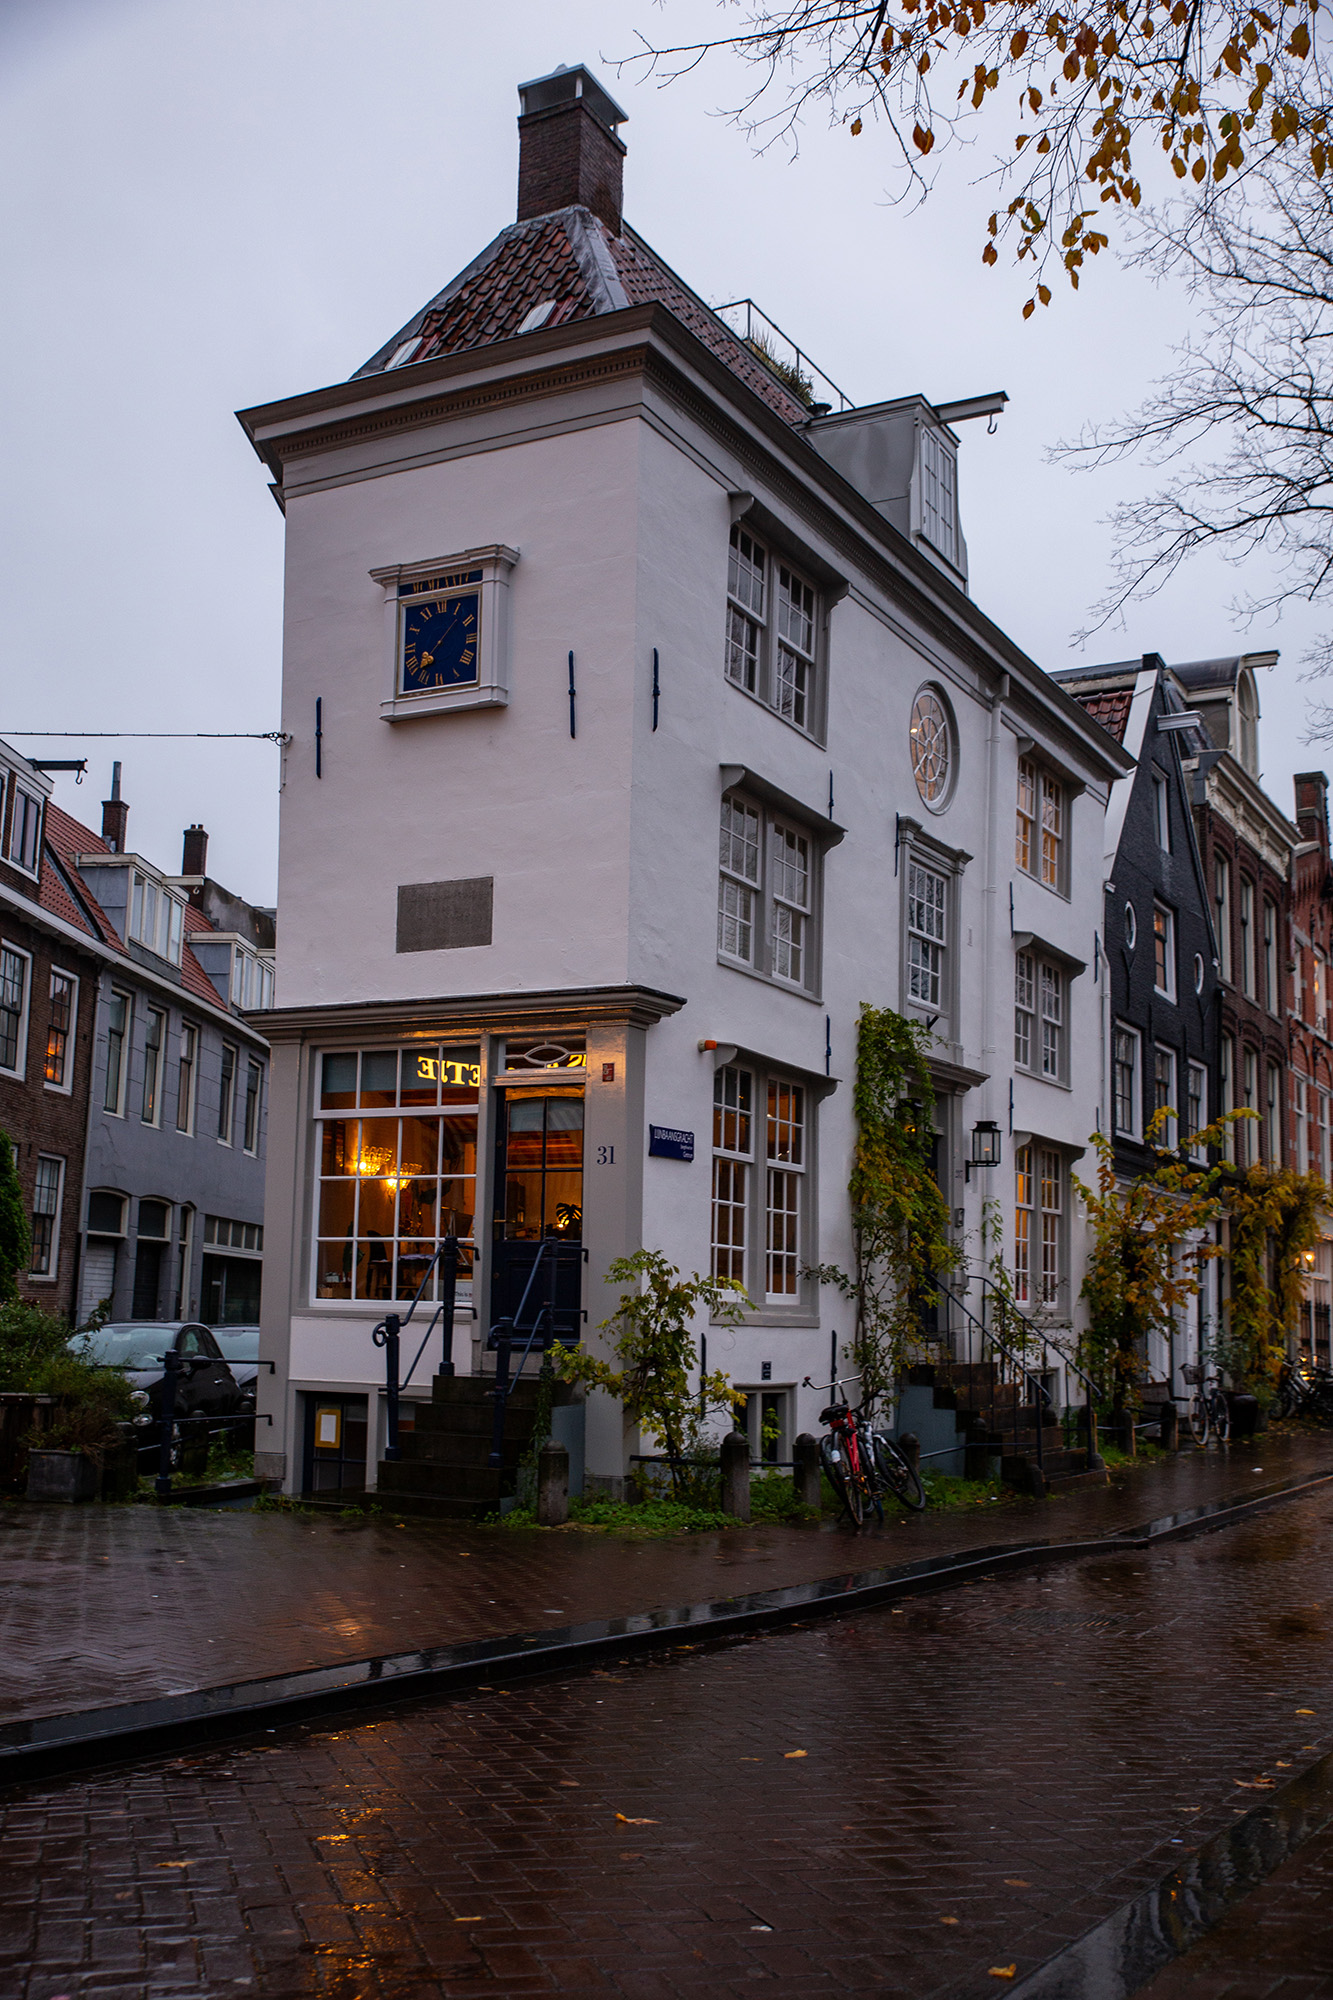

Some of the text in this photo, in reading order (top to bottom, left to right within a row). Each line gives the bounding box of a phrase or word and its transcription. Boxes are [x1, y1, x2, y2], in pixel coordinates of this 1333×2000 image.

[437, 600, 448, 613] XII
[453, 602, 461, 615] I
[419, 607, 432, 622] XI
[462, 614, 475, 627] II
[466, 633, 477, 644] III
[459, 649, 475, 665] IIII
[596, 1146, 616, 1165] 31
